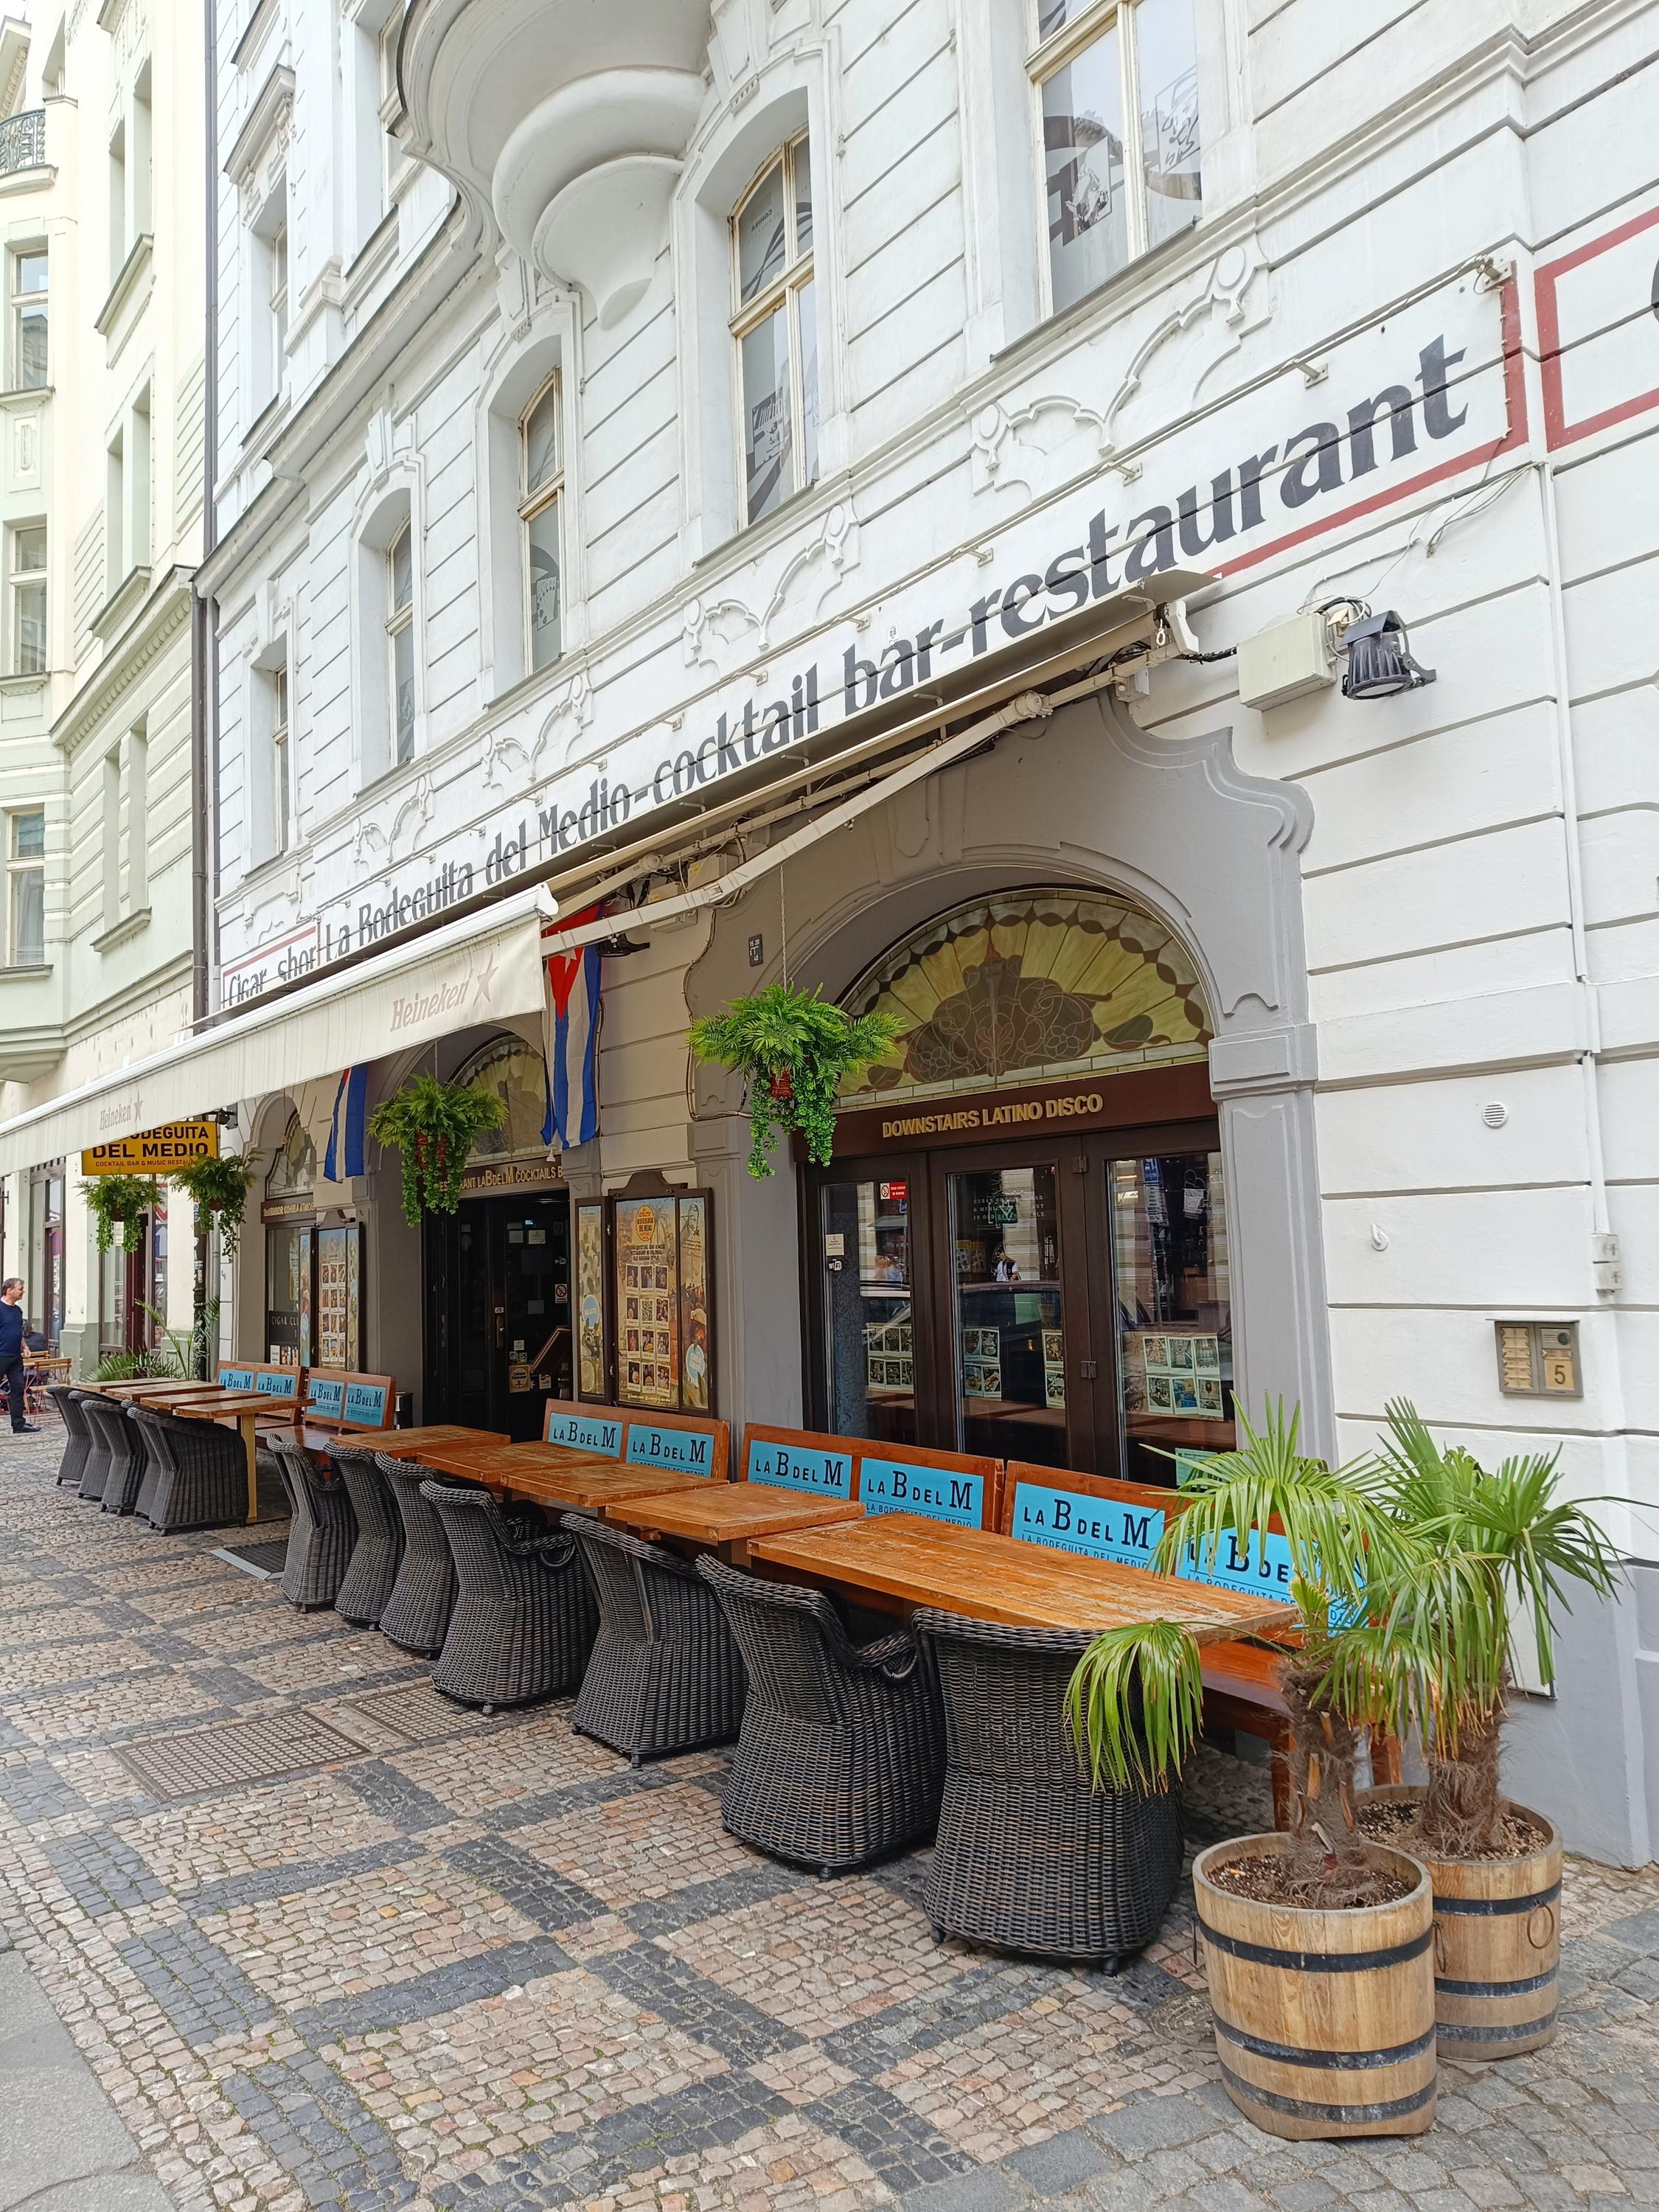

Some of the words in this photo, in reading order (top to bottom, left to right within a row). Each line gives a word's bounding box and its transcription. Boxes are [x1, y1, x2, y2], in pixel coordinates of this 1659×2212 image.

[326, 923, 349, 961] La
[358, 860, 473, 947] Bodeguita
[486, 818, 527, 886] del
[390, 979, 470, 1032] Heineken
[100, 1103, 131, 1130] Heineken
[882, 1110, 980, 1138] DOWNSTAIRS
[982, 1102, 1043, 1126] LATINO
[1046, 1093, 1104, 1118] DISCO
[124, 1126, 209, 1140] DEGUITA
[92, 1144, 135, 1158] DEL
[142, 1142, 209, 1157] MEDIO
[516, 1166, 555, 1183] COCKTAILS
[1554, 1364, 1566, 1385] 5
